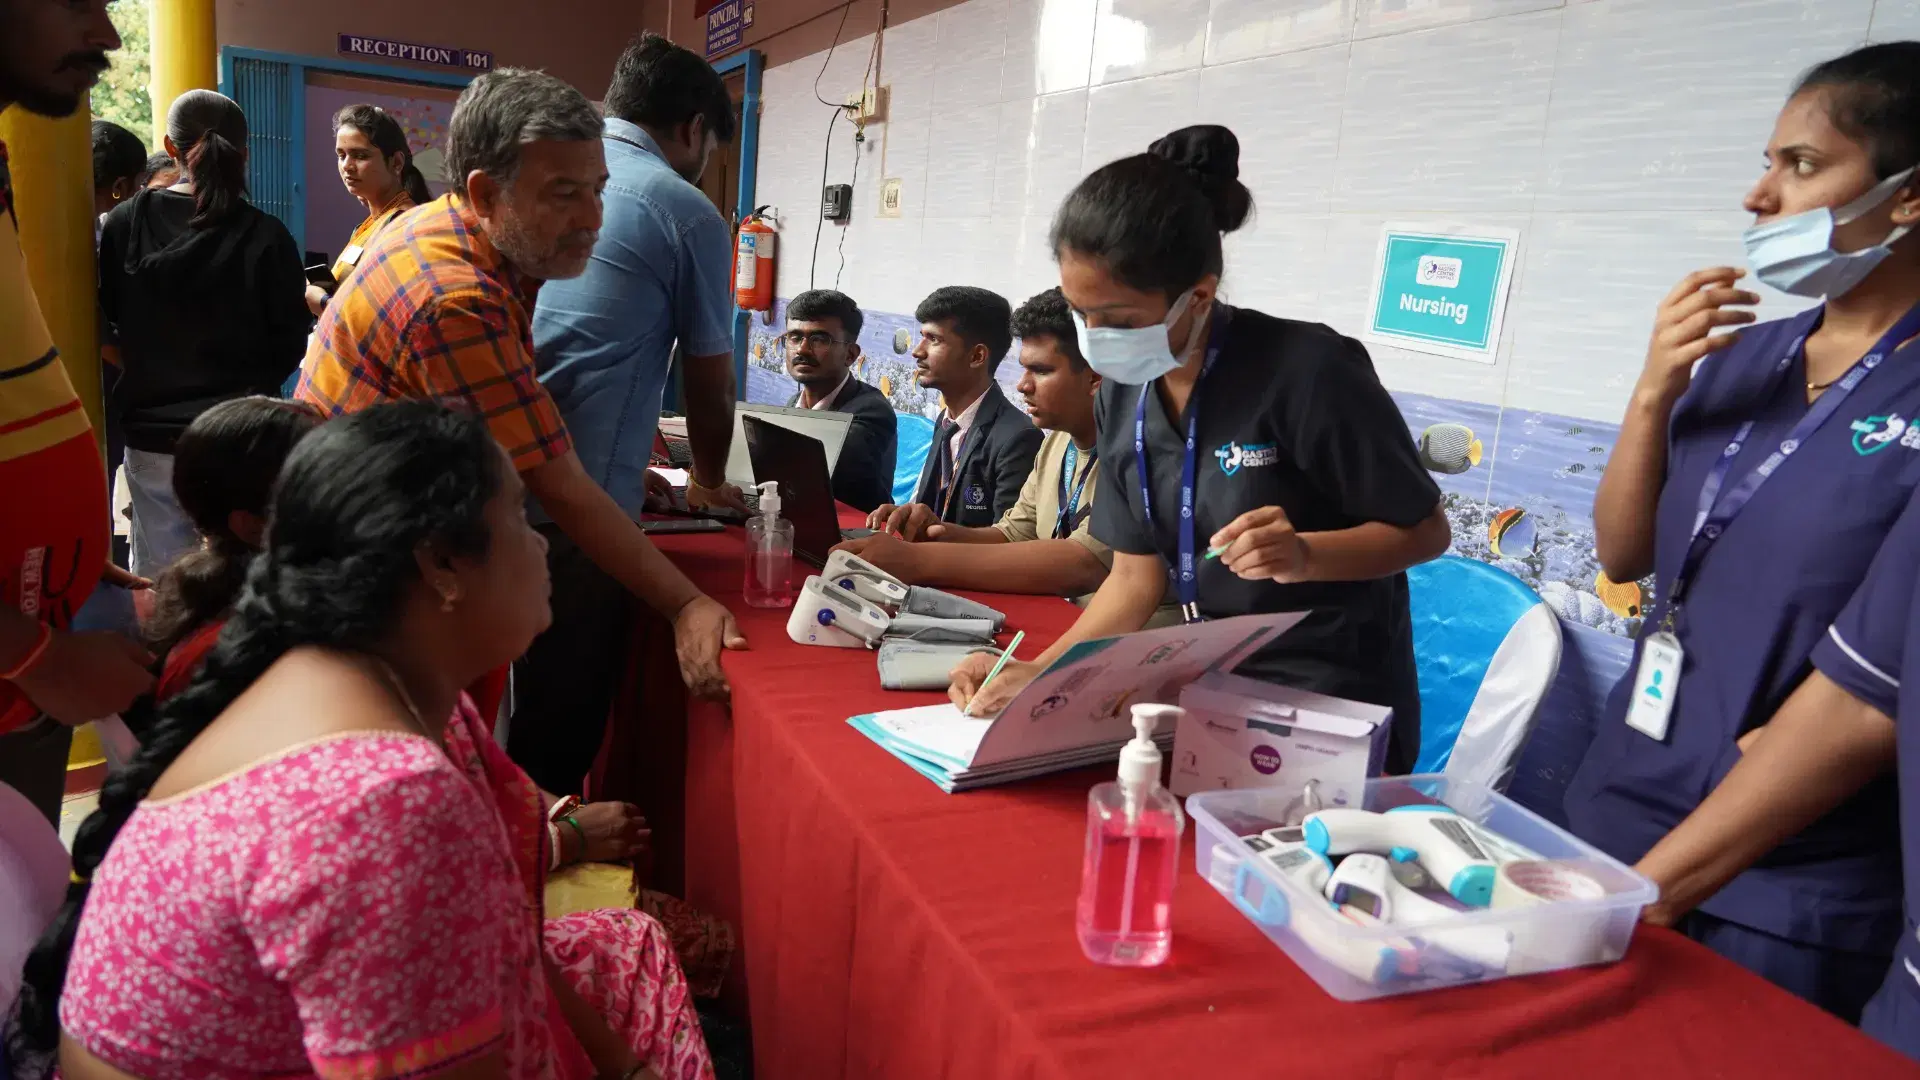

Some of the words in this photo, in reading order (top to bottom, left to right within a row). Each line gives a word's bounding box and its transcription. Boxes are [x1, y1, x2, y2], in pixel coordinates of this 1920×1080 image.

[709, 1, 739, 31] PRINCIPAL
[350, 37, 451, 64] RECEPTION
[465, 52, 488, 69] 101
[1399, 292, 1469, 325] Nursing
